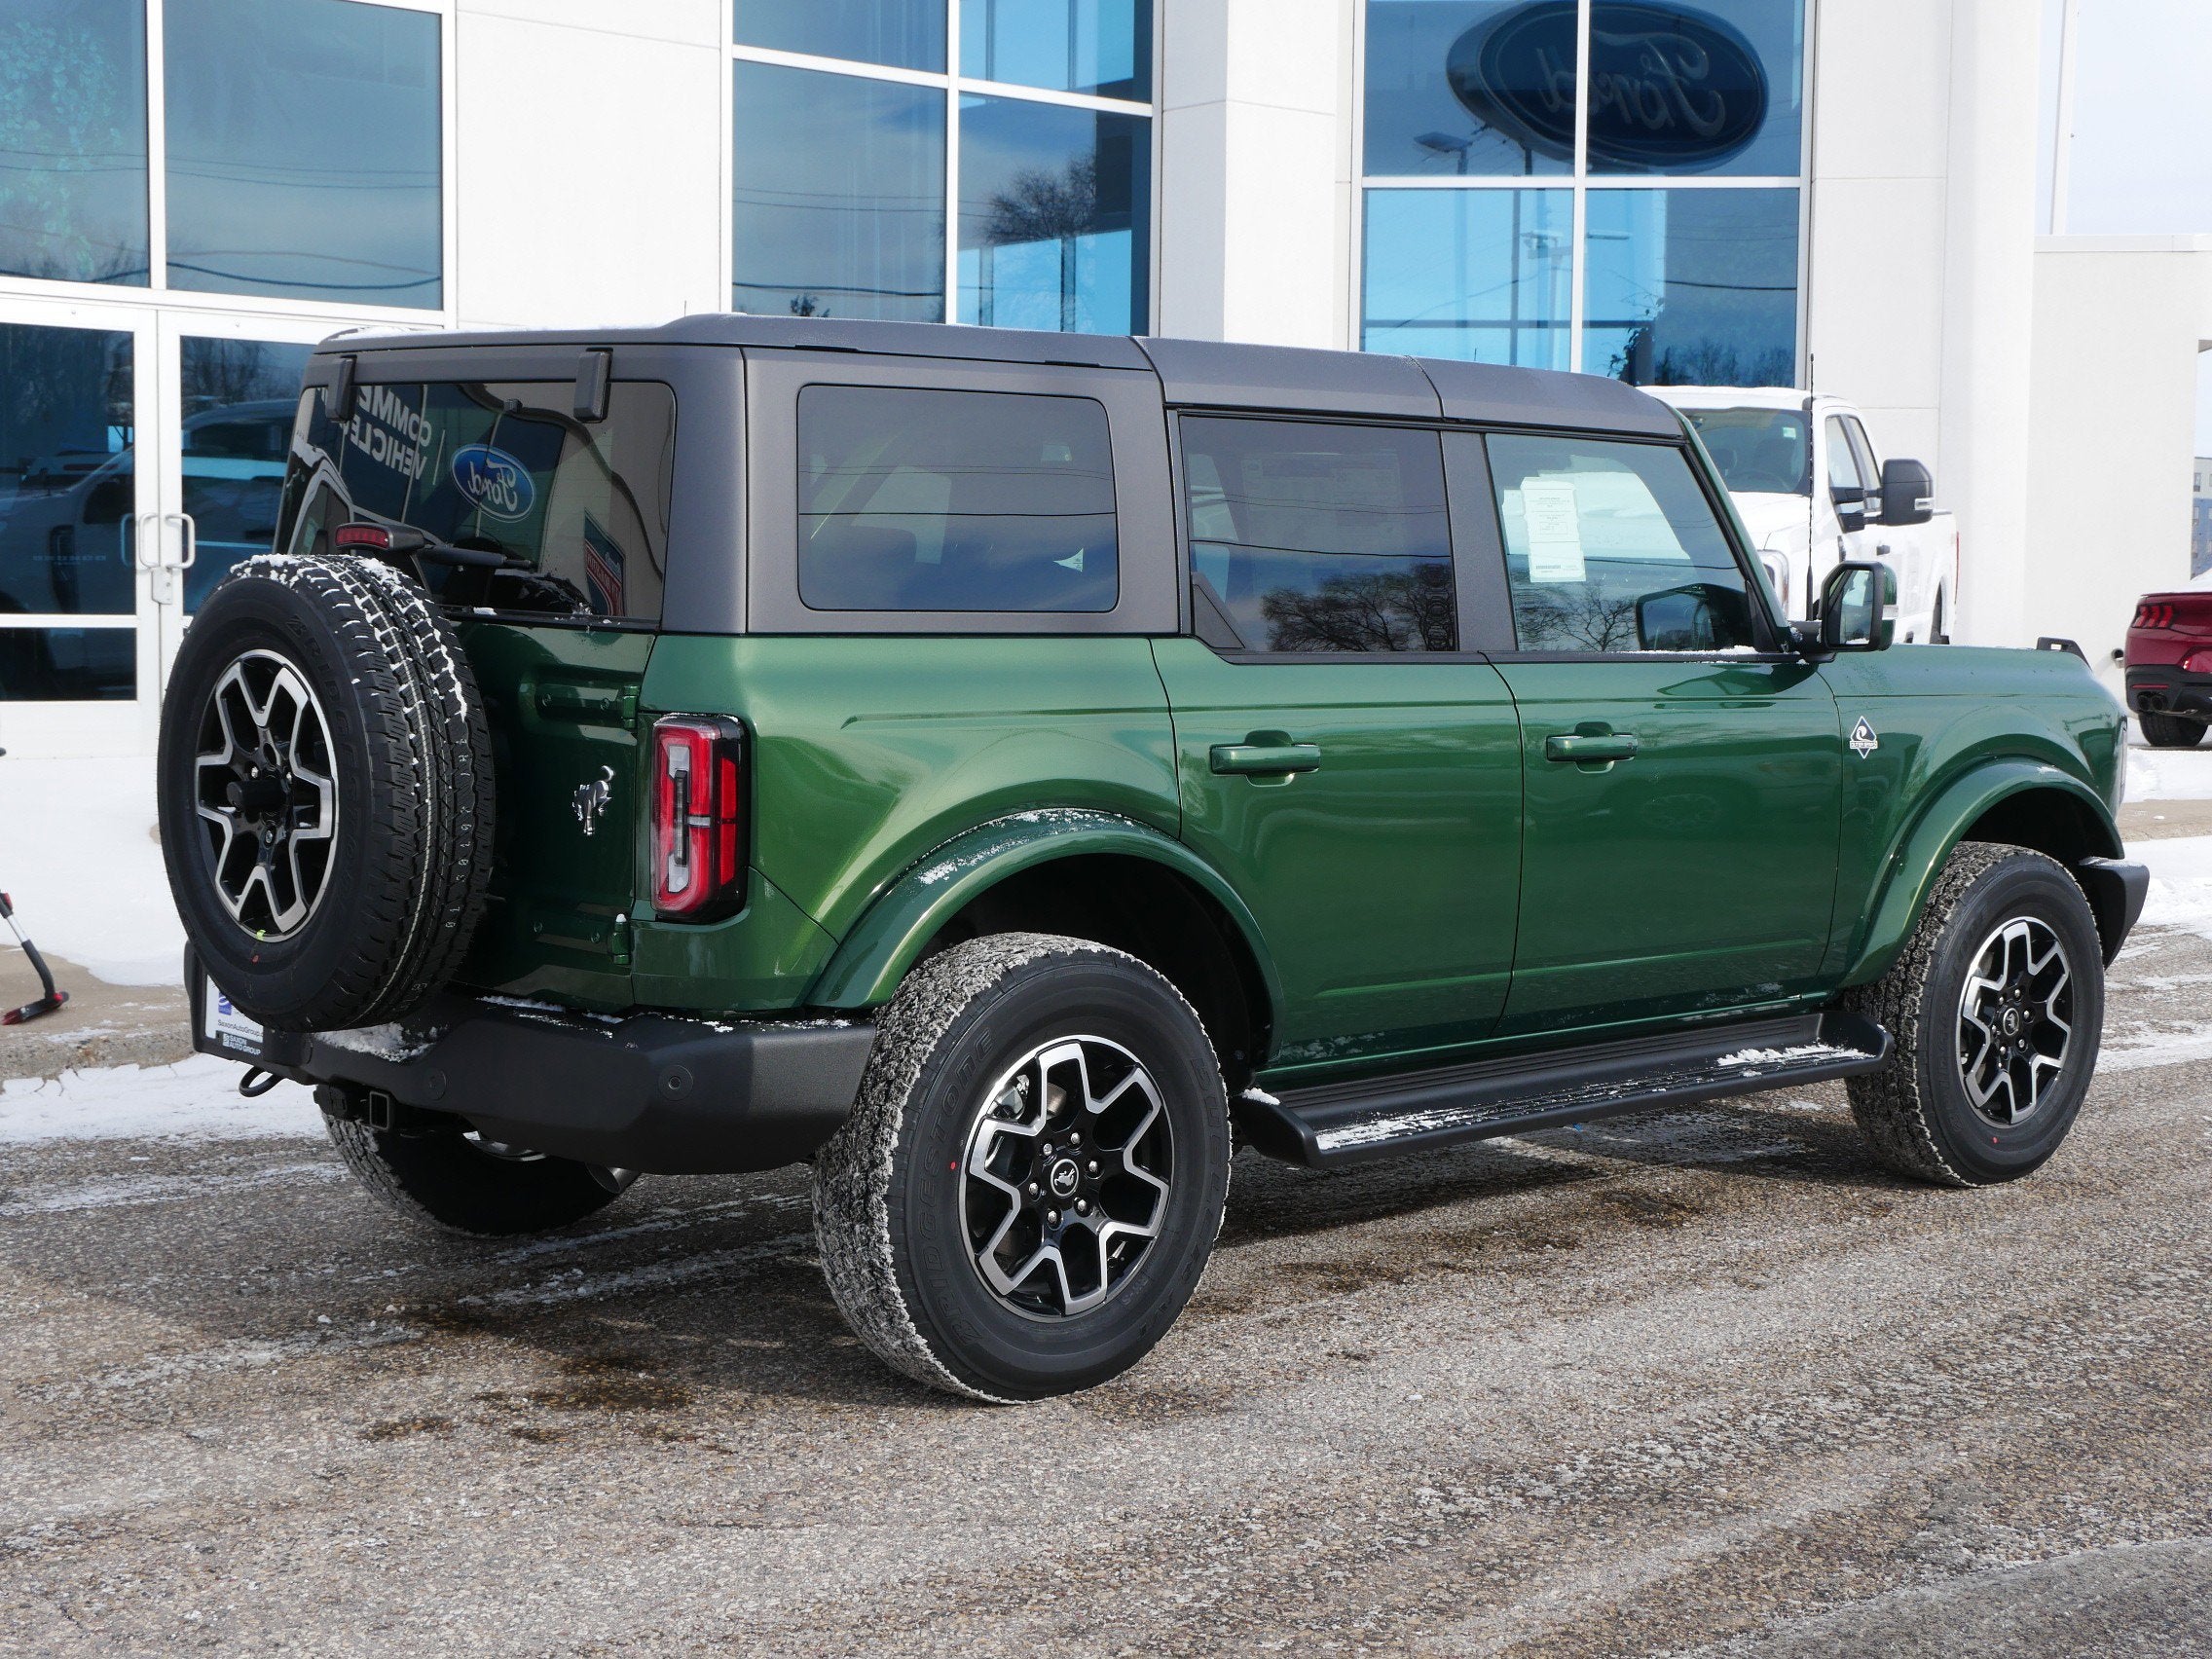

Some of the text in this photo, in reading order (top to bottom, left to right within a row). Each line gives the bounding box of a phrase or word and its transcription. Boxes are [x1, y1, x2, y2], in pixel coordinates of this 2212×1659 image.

[229, 1034, 247, 1046] SAXON
[229, 1041, 261, 1055] AUTO GROUP
[917, 1029, 995, 1346] BRIDGESTONE
